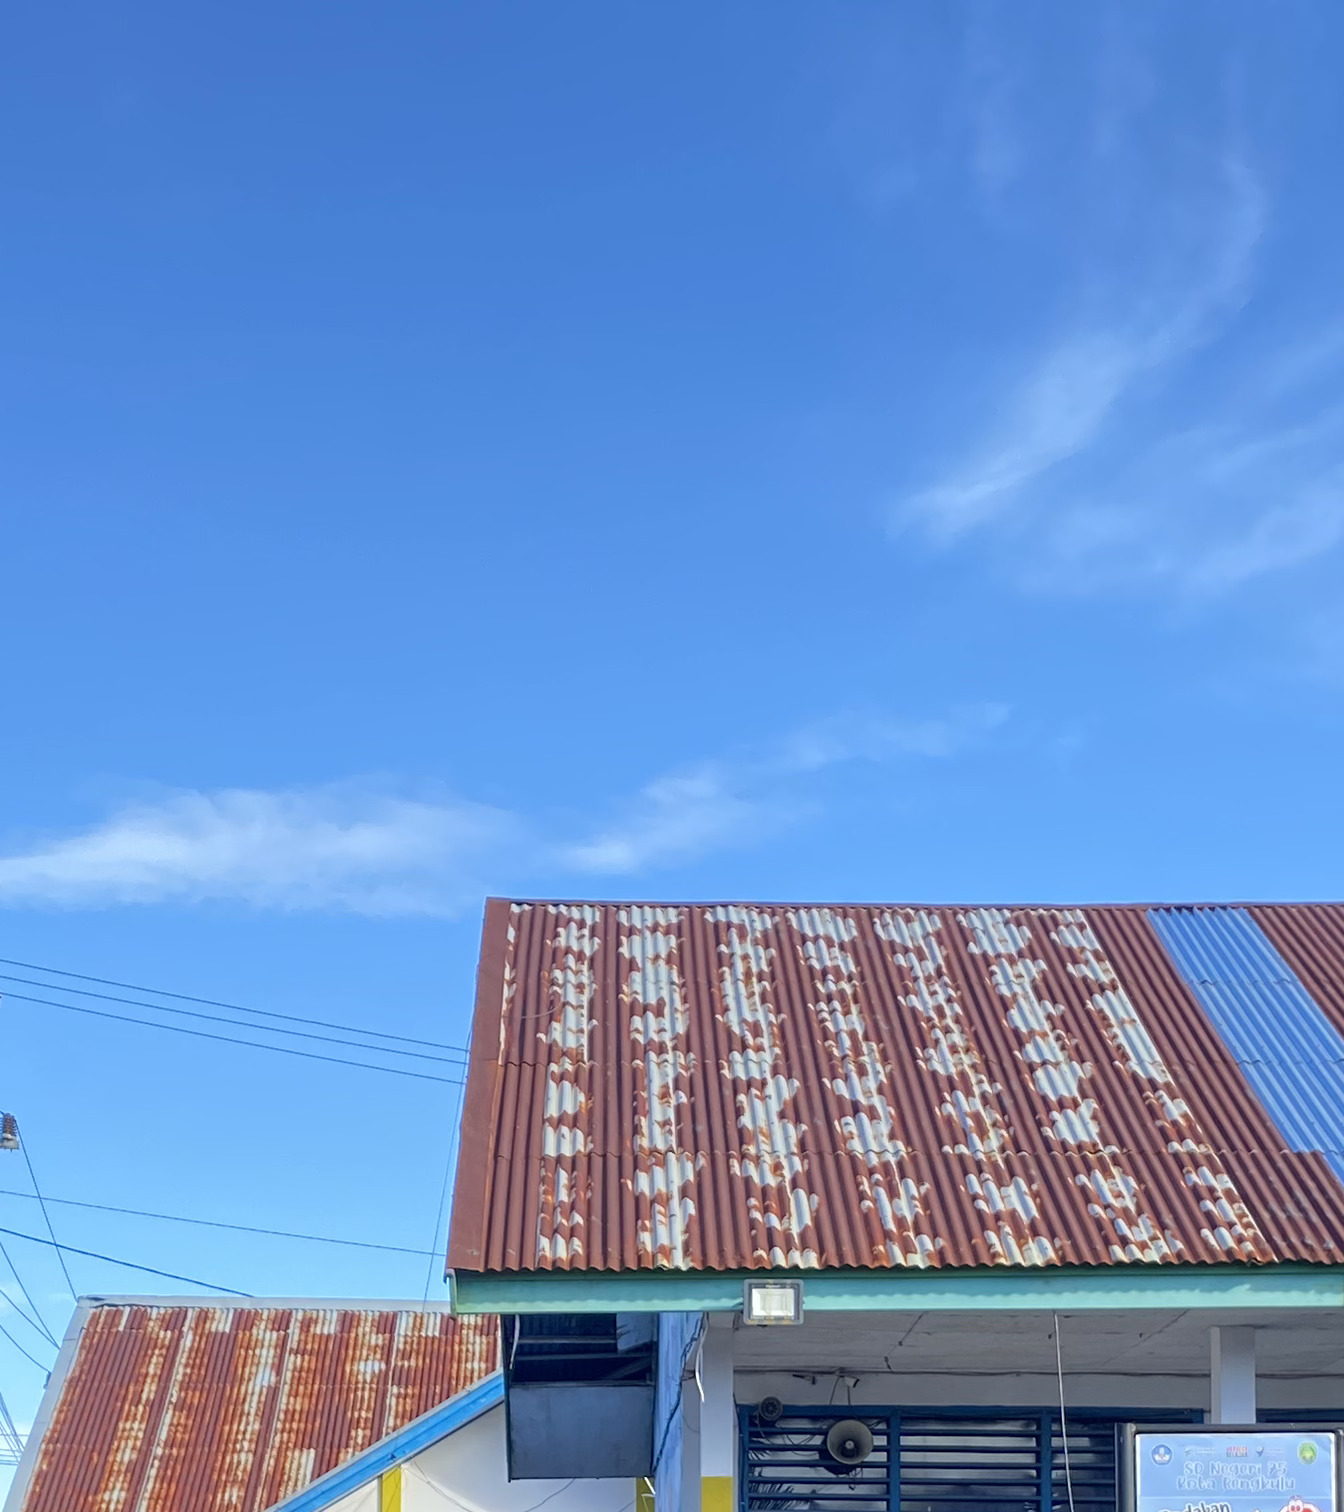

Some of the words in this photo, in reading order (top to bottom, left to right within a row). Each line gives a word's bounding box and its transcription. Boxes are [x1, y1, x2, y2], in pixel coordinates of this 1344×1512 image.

[1184, 1461, 1204, 1475] SD
[1210, 1461, 1262, 1478] Negeri
[1267, 1461, 1288, 1476] 75
[1177, 1476, 1216, 1490] Kota
[1223, 1476, 1295, 1491] Bengkulu
